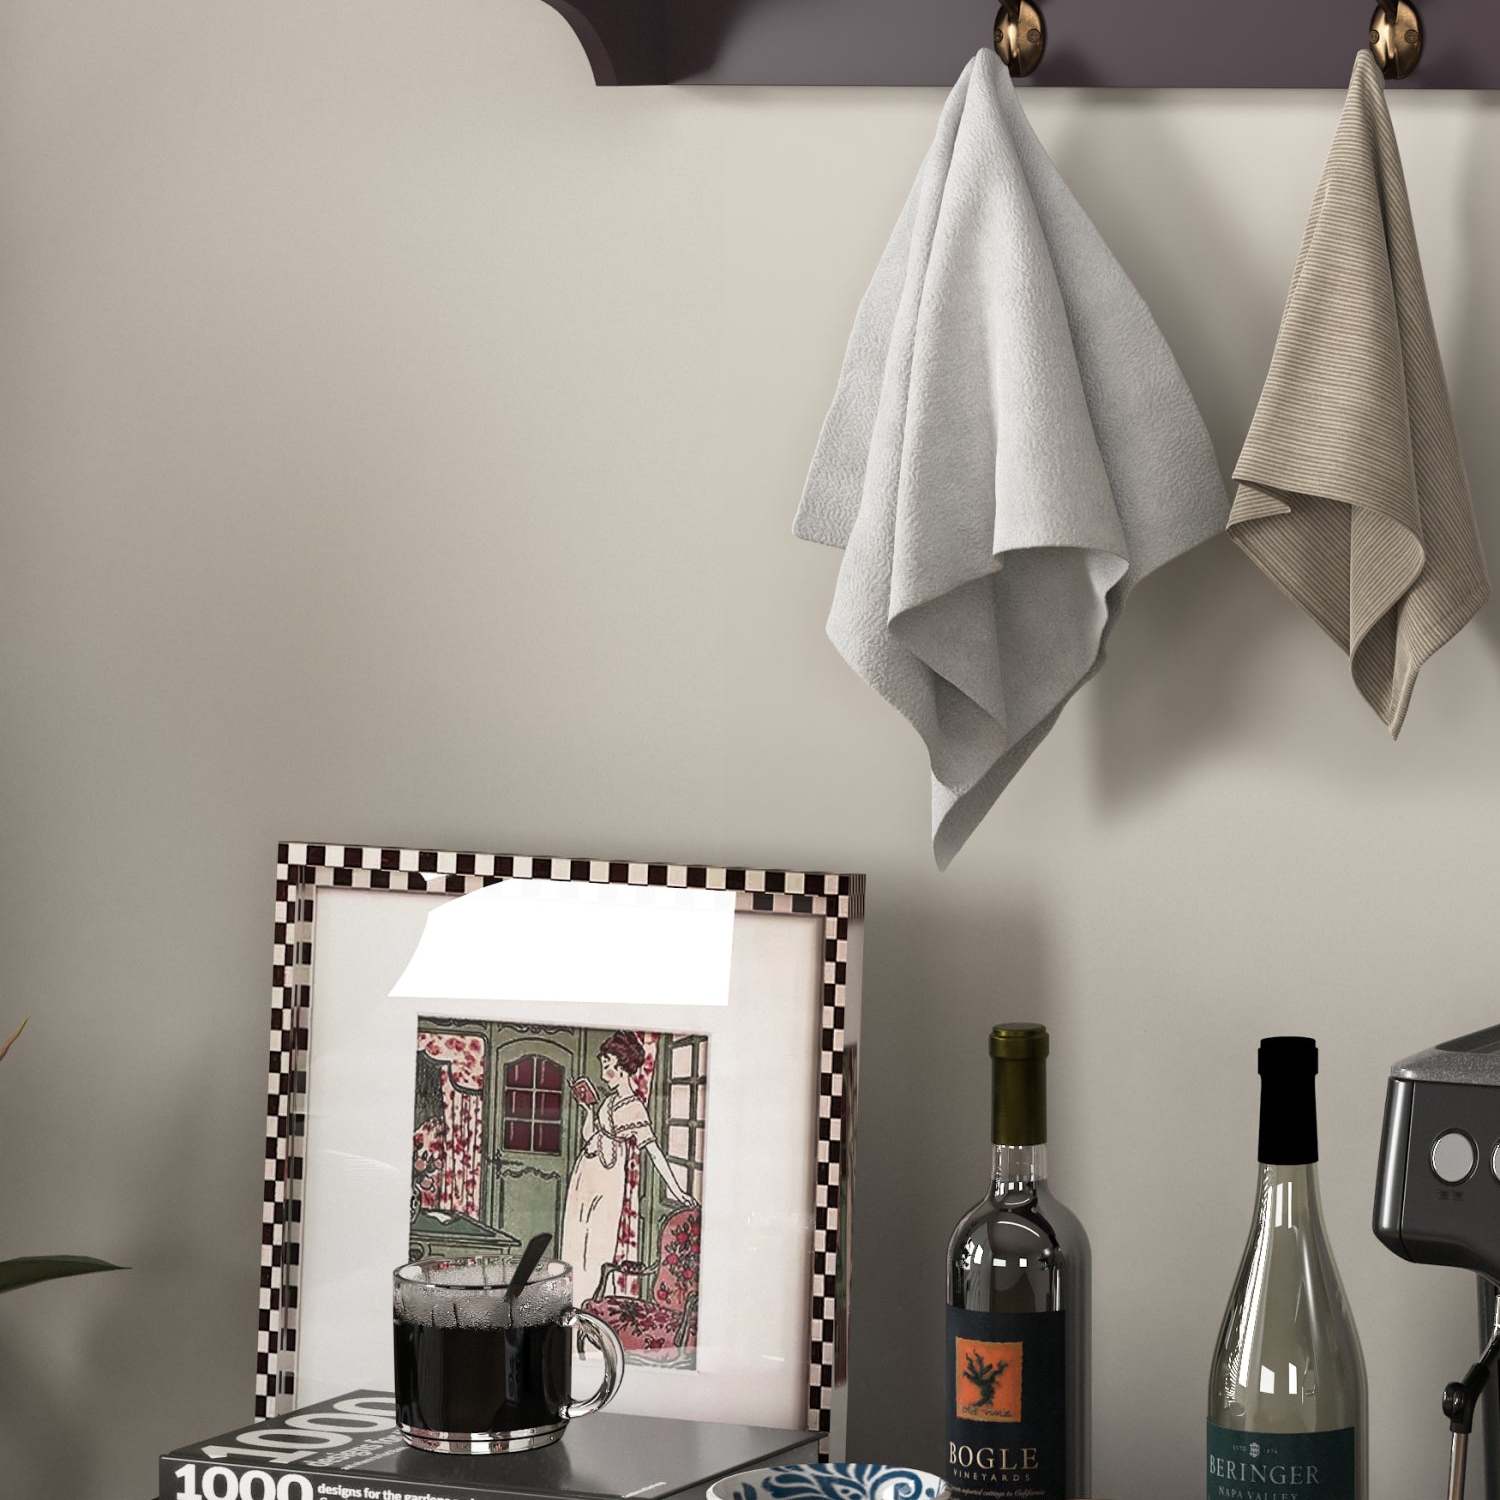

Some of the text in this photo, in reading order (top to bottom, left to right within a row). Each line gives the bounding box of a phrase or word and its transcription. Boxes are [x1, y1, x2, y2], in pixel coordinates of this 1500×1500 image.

[949, 1441, 1040, 1471] BOGLE
[953, 1469, 1031, 1482] VINEYARDS
[1209, 1453, 1321, 1485] BERINGER
[175, 1463, 313, 1500] 1000
[317, 1483, 362, 1499] designs
[363, 1487, 381, 1500] for
[382, 1489, 403, 1500] the
[1218, 1485, 1243, 1499] NAPA
